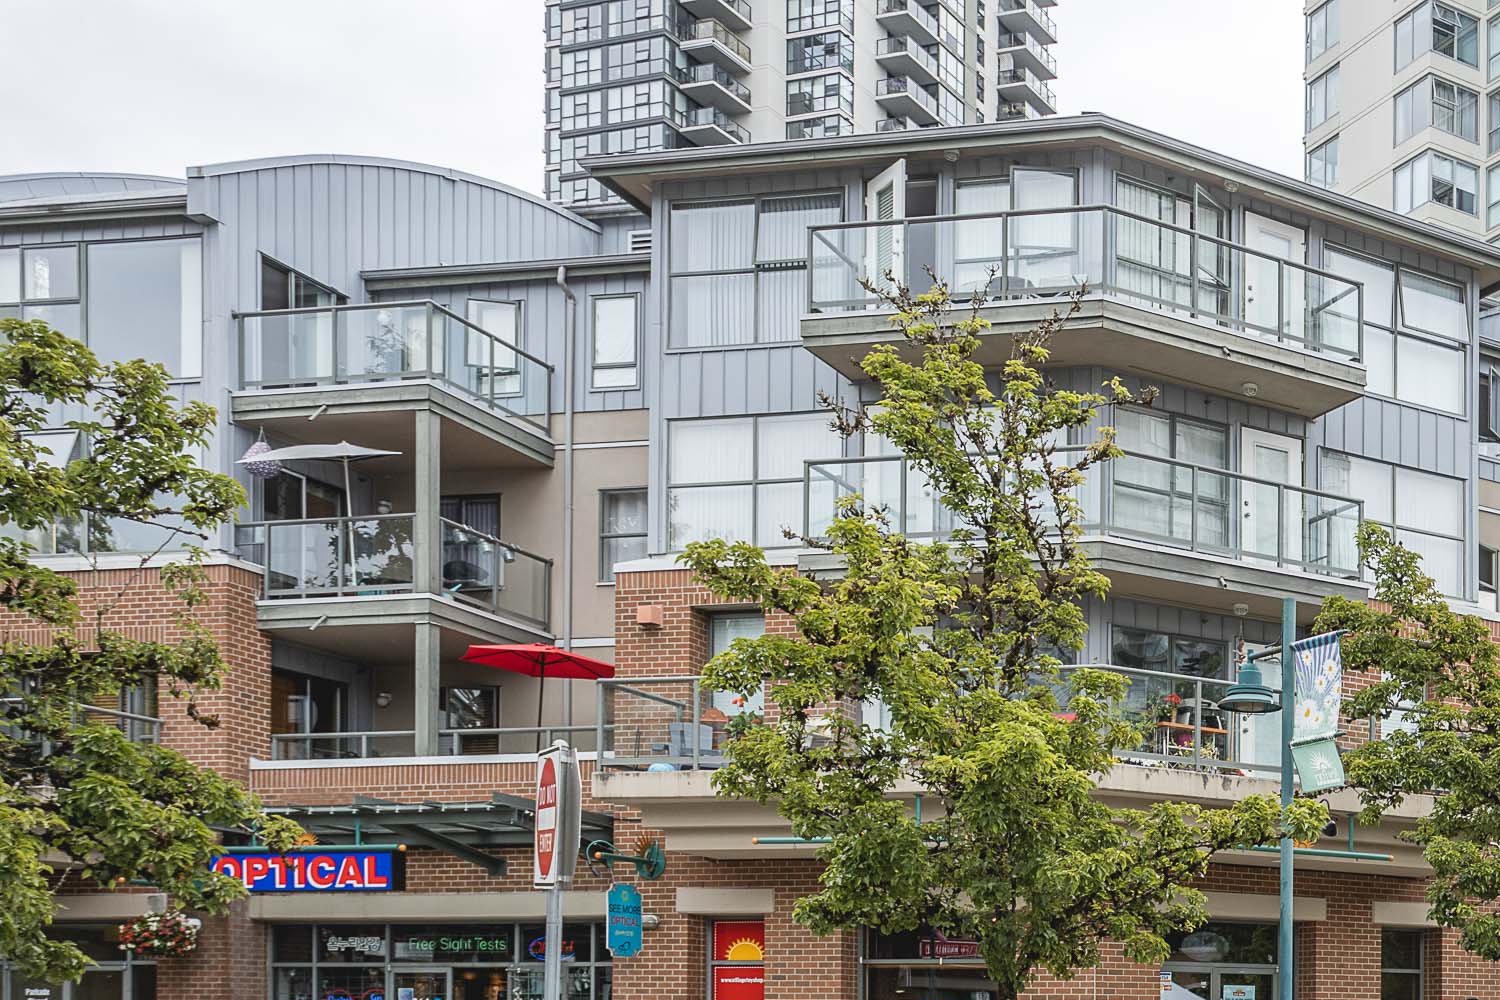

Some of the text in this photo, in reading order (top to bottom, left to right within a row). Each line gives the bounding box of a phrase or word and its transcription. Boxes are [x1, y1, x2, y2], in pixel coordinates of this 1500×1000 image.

[539, 783, 556, 806] DO NOT
[539, 832, 553, 854] ENTER
[212, 855, 388, 889] OPTICAL
[408, 936, 506, 952] Free Sight Tests
